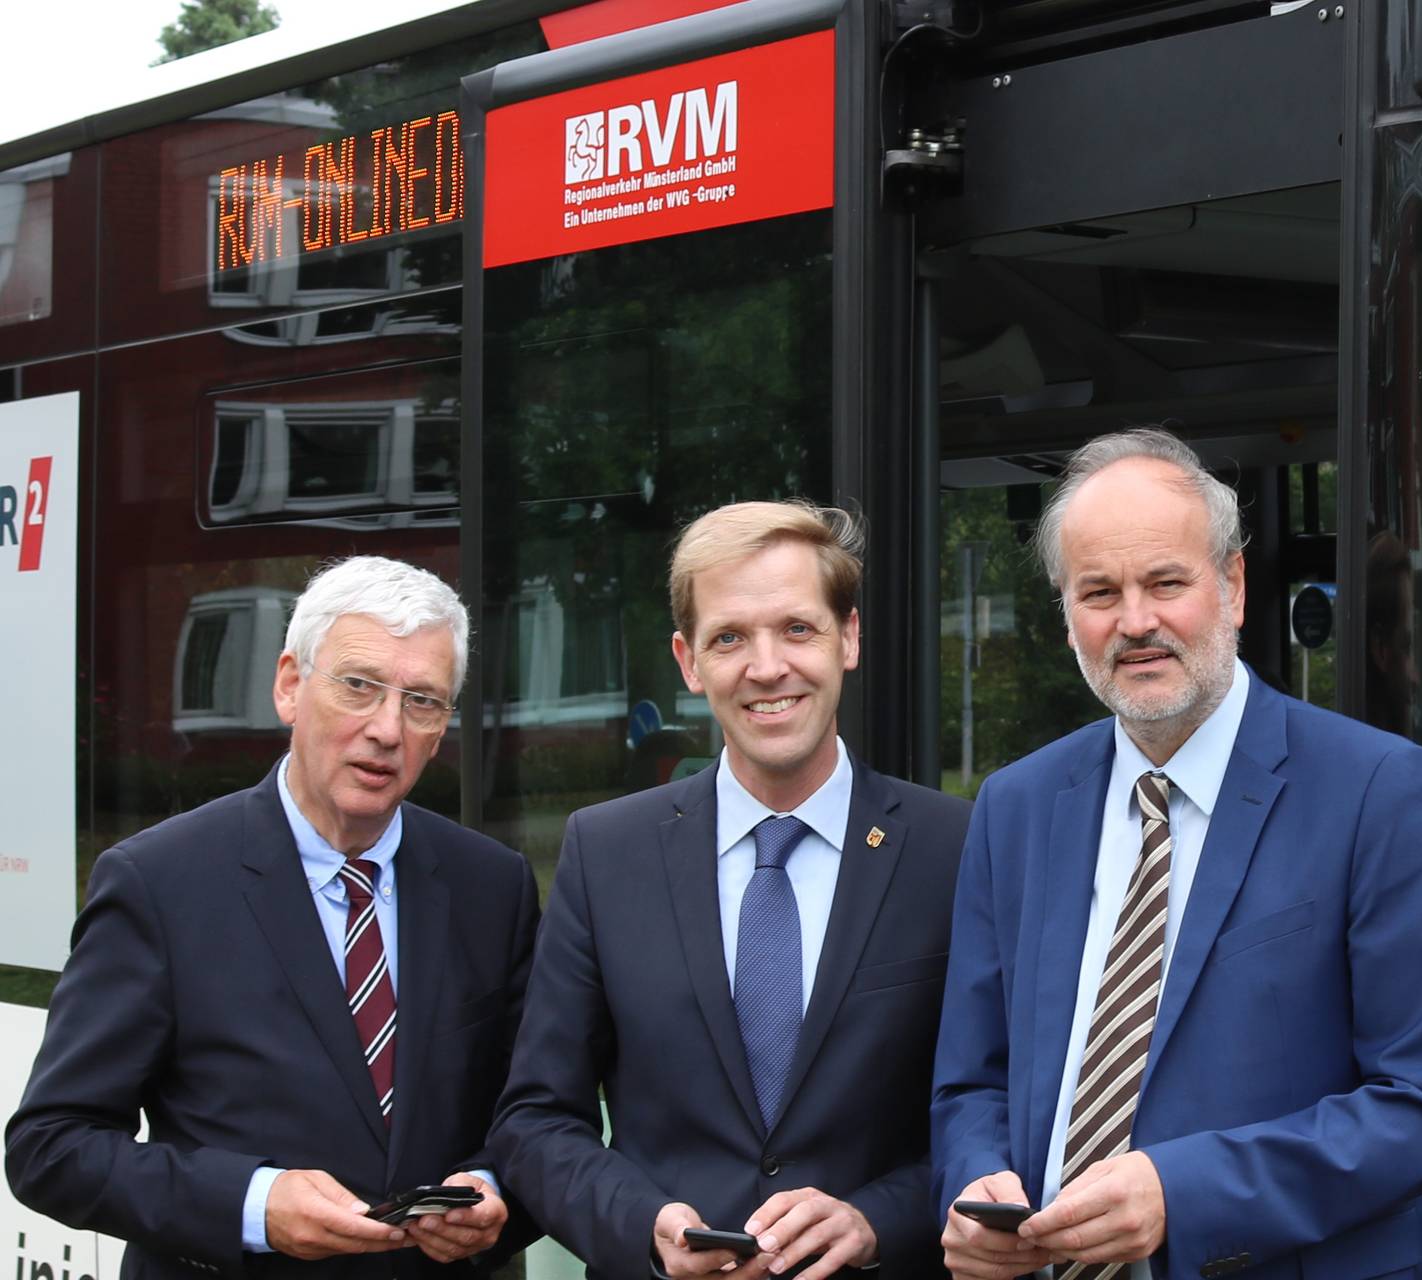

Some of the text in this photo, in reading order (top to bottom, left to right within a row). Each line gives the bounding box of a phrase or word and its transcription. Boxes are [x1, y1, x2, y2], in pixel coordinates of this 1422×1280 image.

[607, 80, 738, 177] RVM
[219, 110, 464, 270] RVM-ONLINED
[564, 155, 737, 206] Regionalverkehr Münsterland GmbH
[564, 212, 580, 229] Ein
[581, 202, 645, 225] Unternehmen
[646, 197, 664, 212] der
[666, 190, 690, 208] WVG
[28, 480, 43, 526] 2
